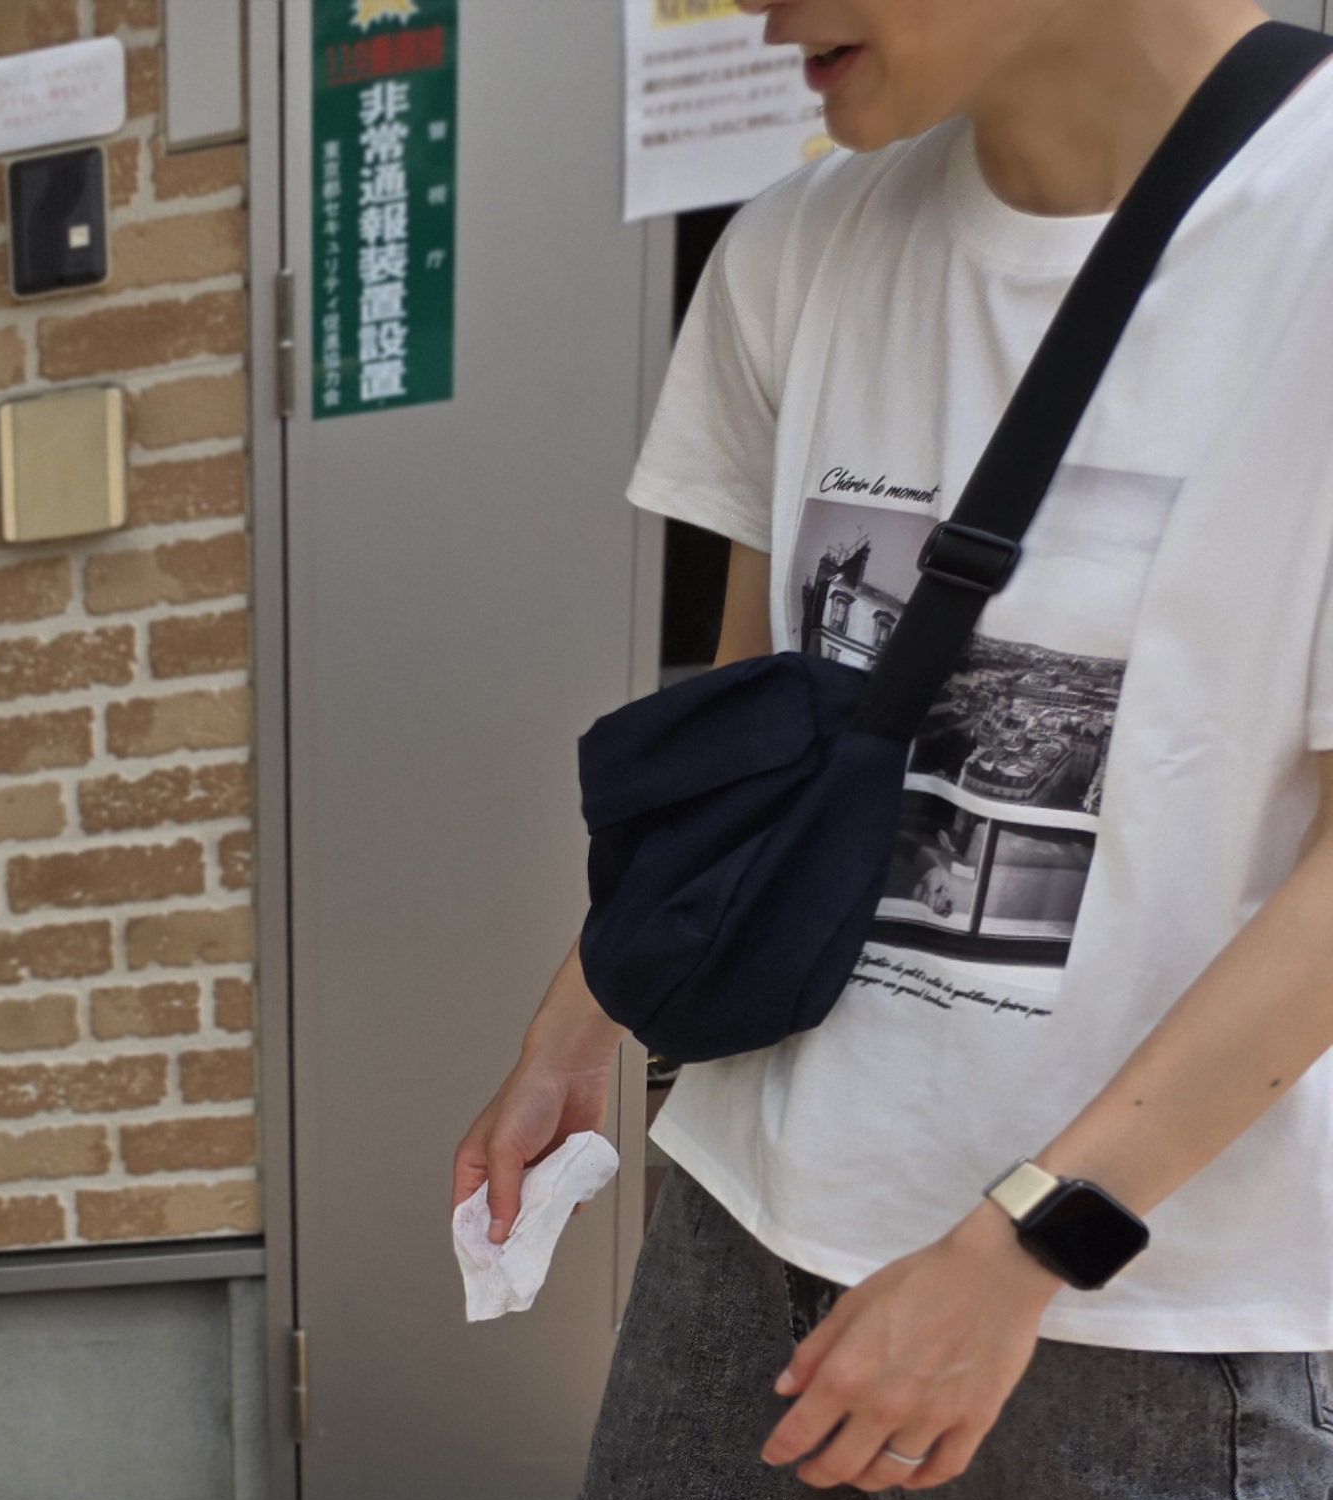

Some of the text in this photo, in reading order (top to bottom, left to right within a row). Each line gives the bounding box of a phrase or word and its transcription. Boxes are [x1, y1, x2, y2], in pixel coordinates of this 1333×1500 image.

[358, 79, 410, 402] 非常通報装置設置
[819, 466, 871, 494] Chérir
[884, 484, 942, 504] moment
